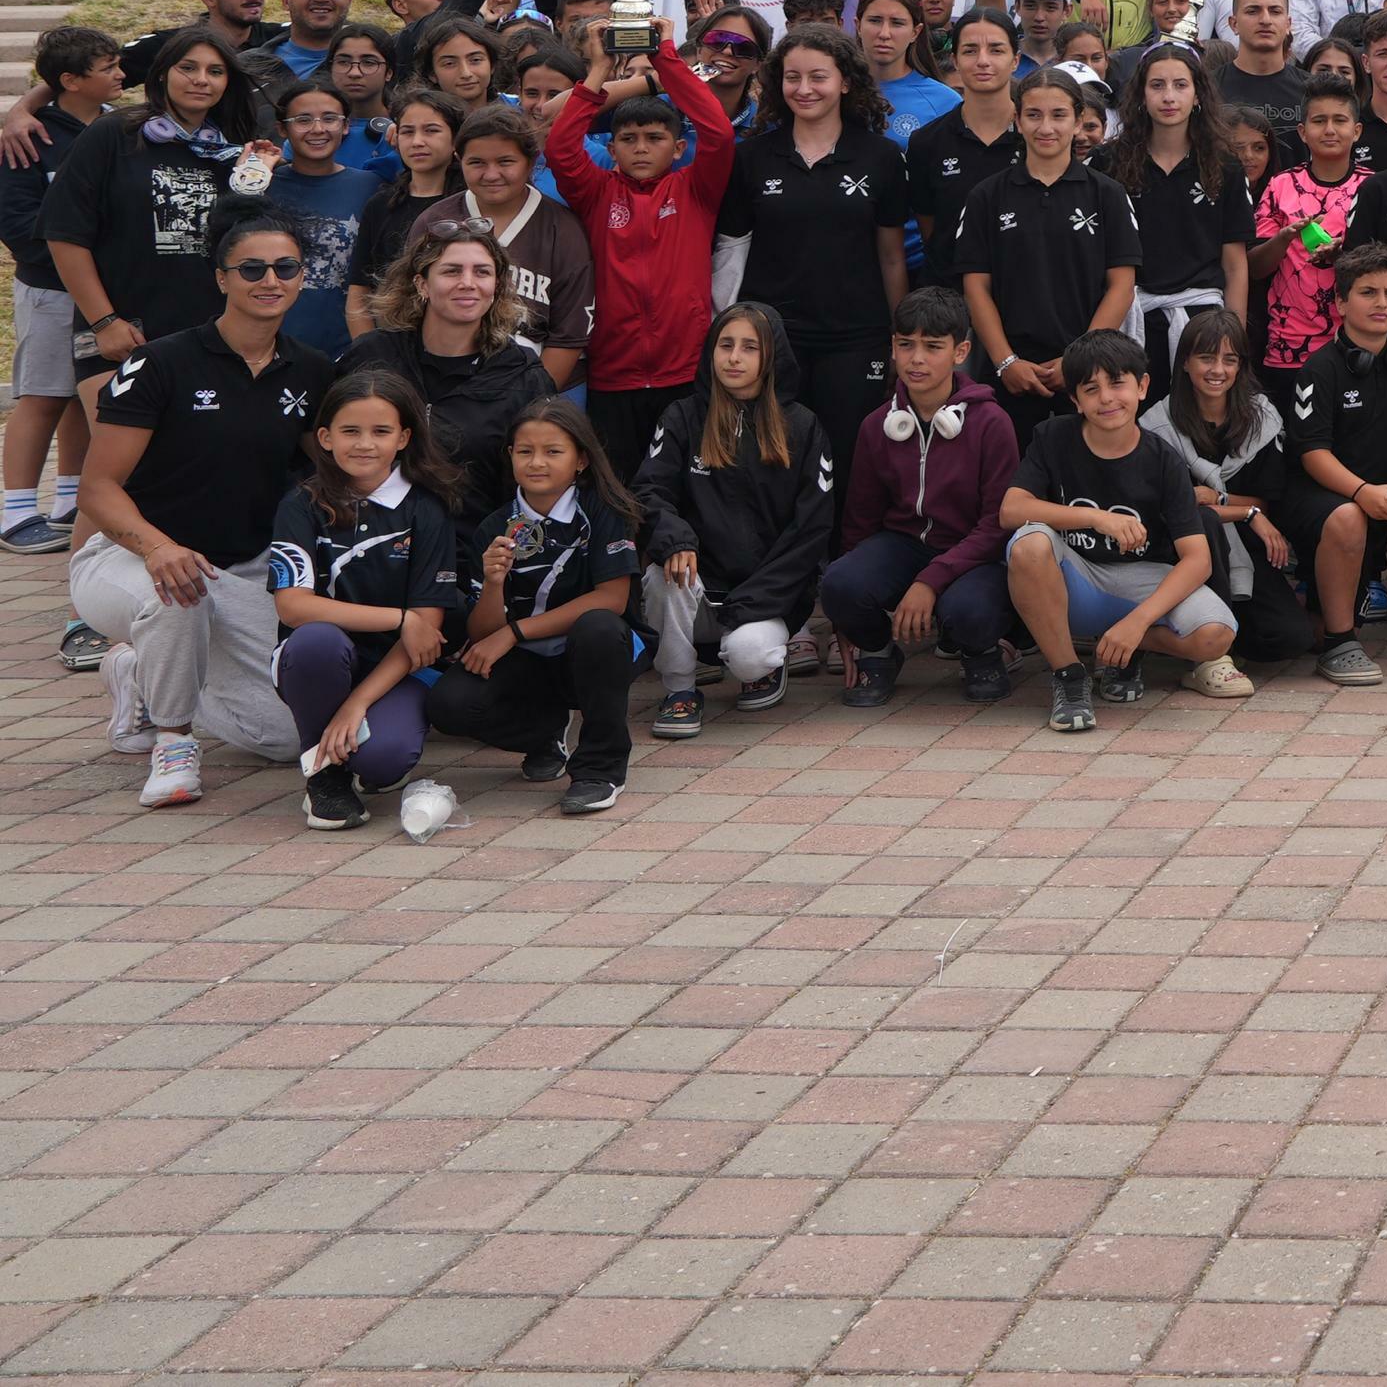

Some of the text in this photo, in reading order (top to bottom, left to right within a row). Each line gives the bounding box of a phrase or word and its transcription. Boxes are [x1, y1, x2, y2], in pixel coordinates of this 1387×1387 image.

[762, 188, 783, 196] hummel
[193, 403, 220, 411] hummel
[1343, 401, 1363, 409] hummel
